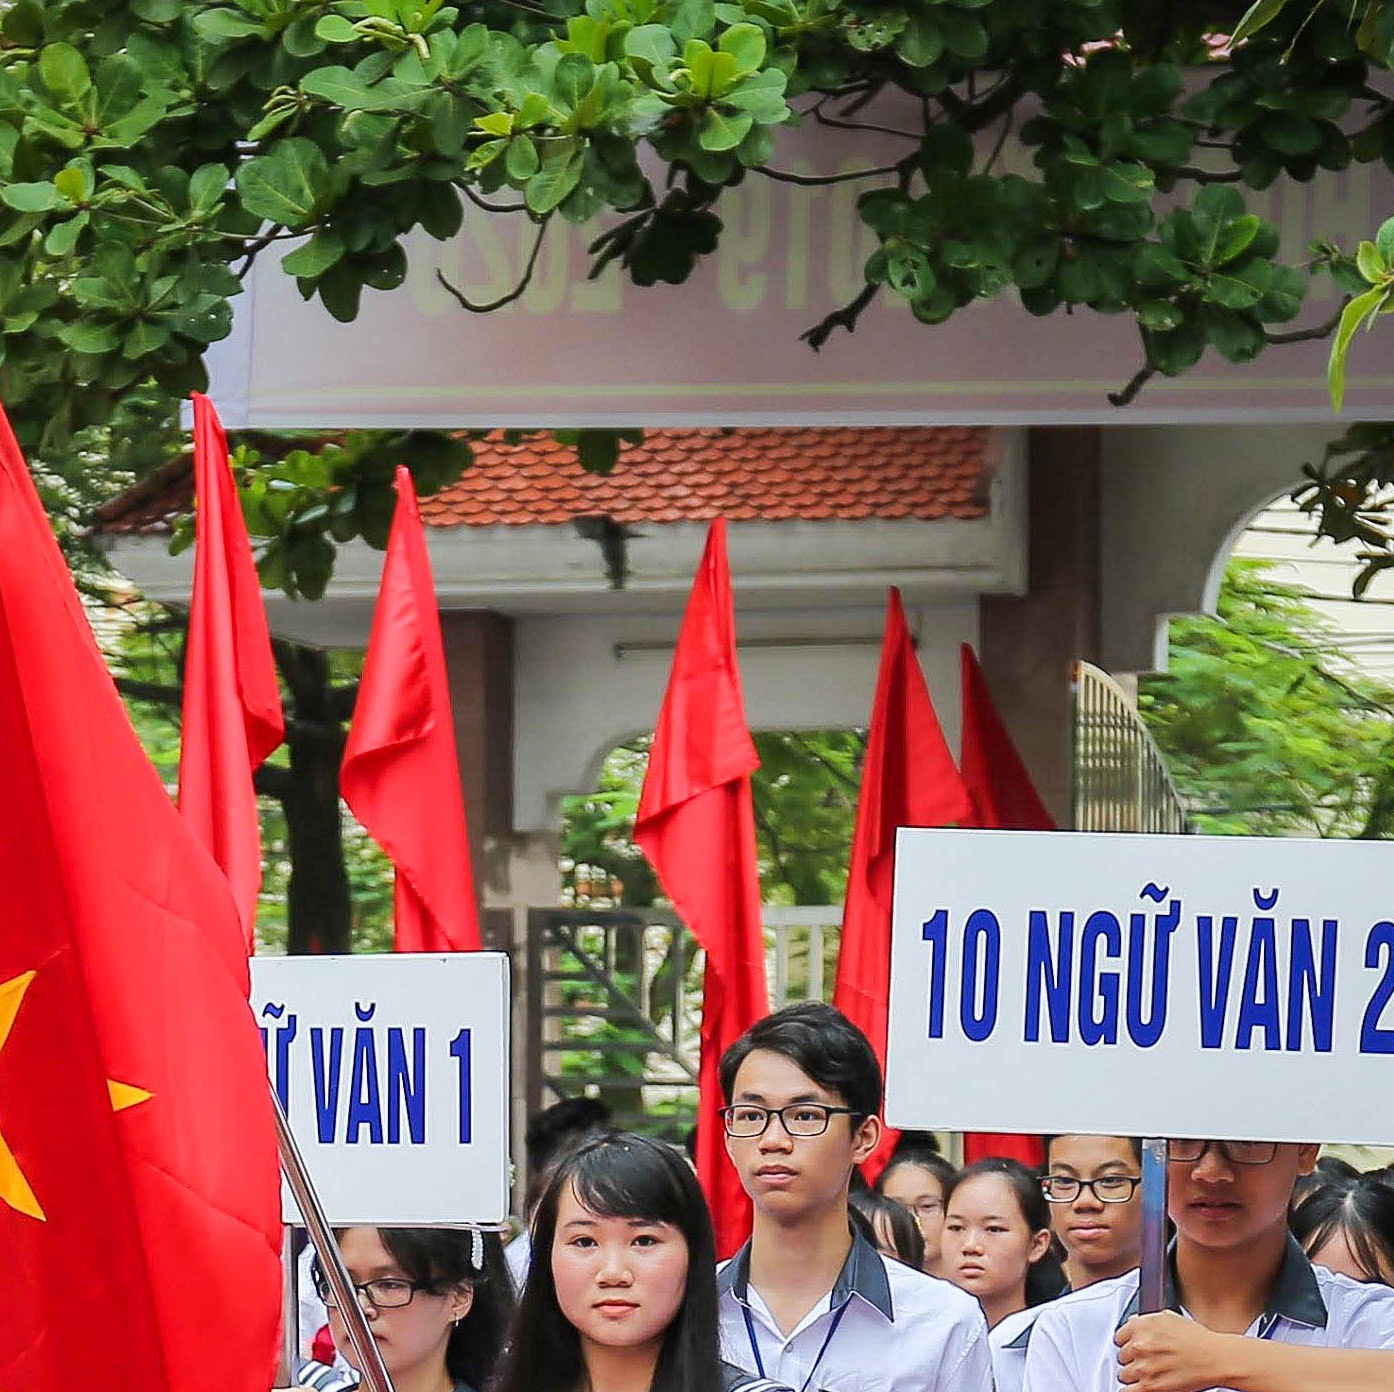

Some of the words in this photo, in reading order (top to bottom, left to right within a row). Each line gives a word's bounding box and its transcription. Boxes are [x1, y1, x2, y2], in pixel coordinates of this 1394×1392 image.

[921, 908, 1001, 1042] 10
[1023, 882, 1181, 1048] NGỮ
[1196, 887, 1338, 1053] VĂN
[310, 1002, 426, 1144] VĂN
[449, 1028, 472, 1144] 1
